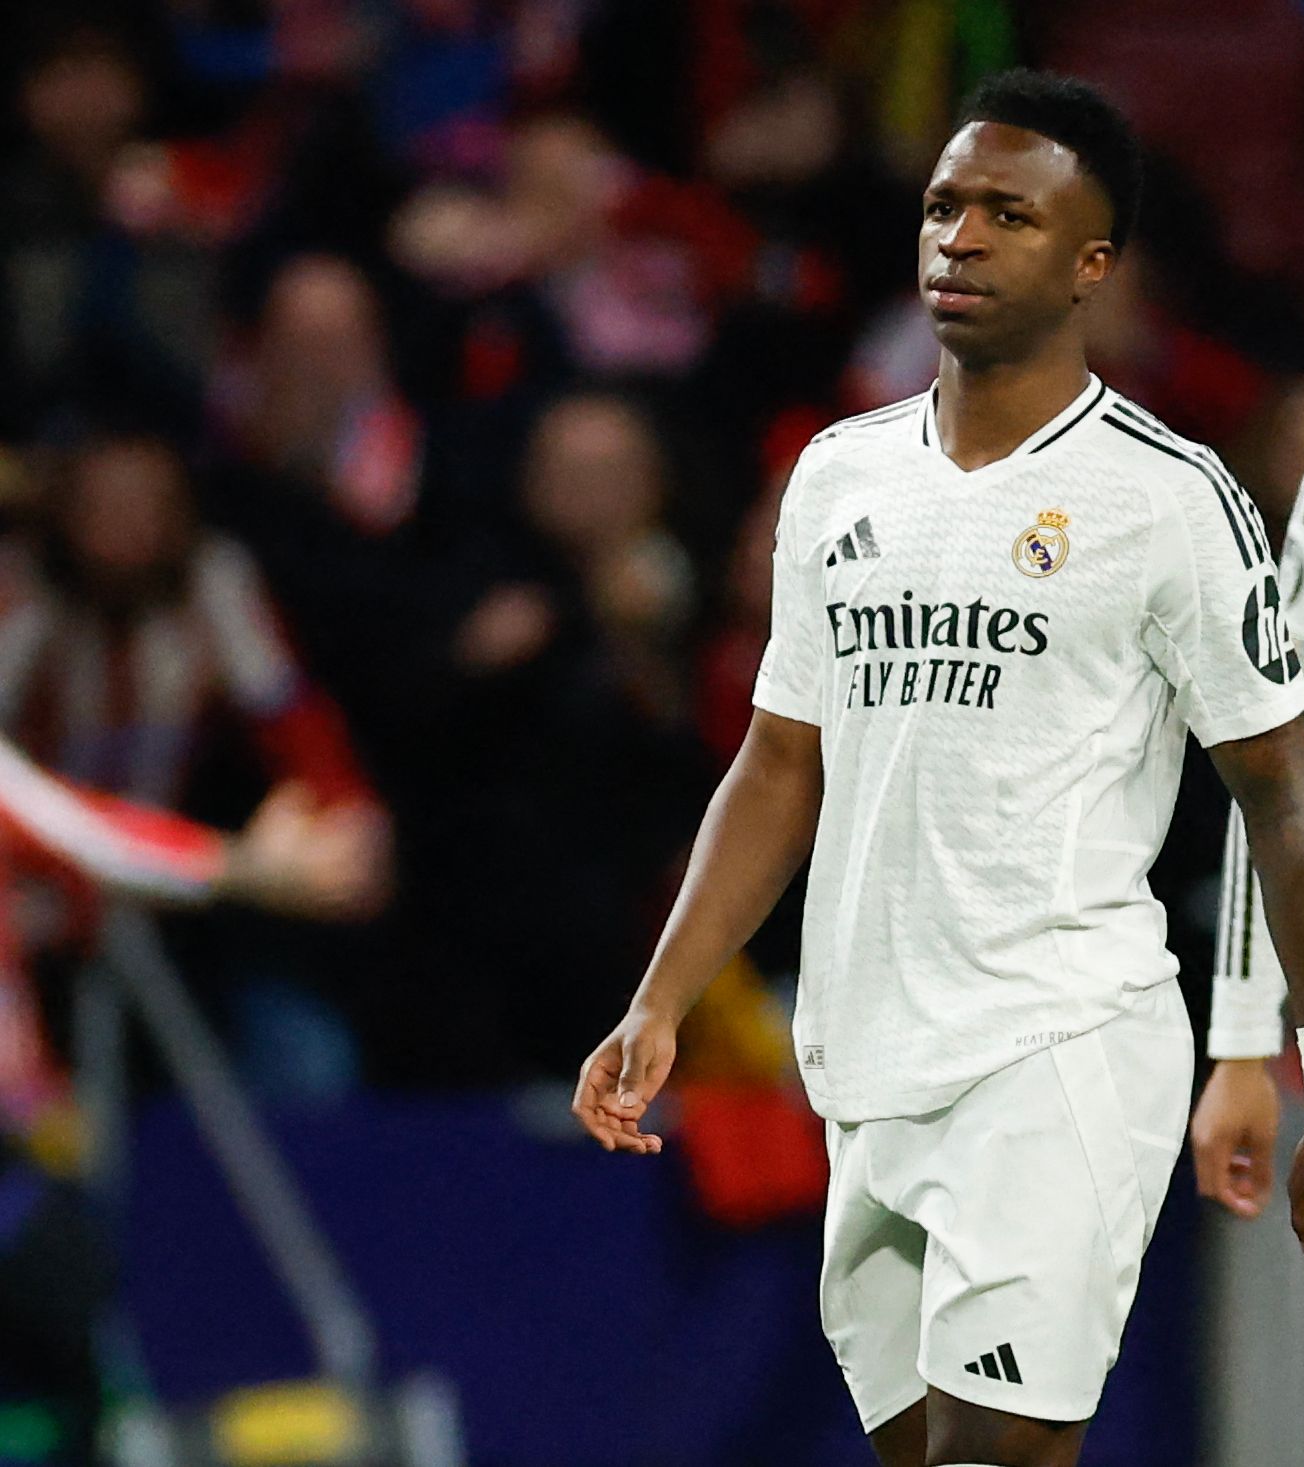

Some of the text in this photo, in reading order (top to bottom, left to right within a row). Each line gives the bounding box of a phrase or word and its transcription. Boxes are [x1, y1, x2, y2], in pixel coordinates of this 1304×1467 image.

[826, 590, 1049, 659] Emirates
[847, 659, 1001, 709] FLY BTTER
